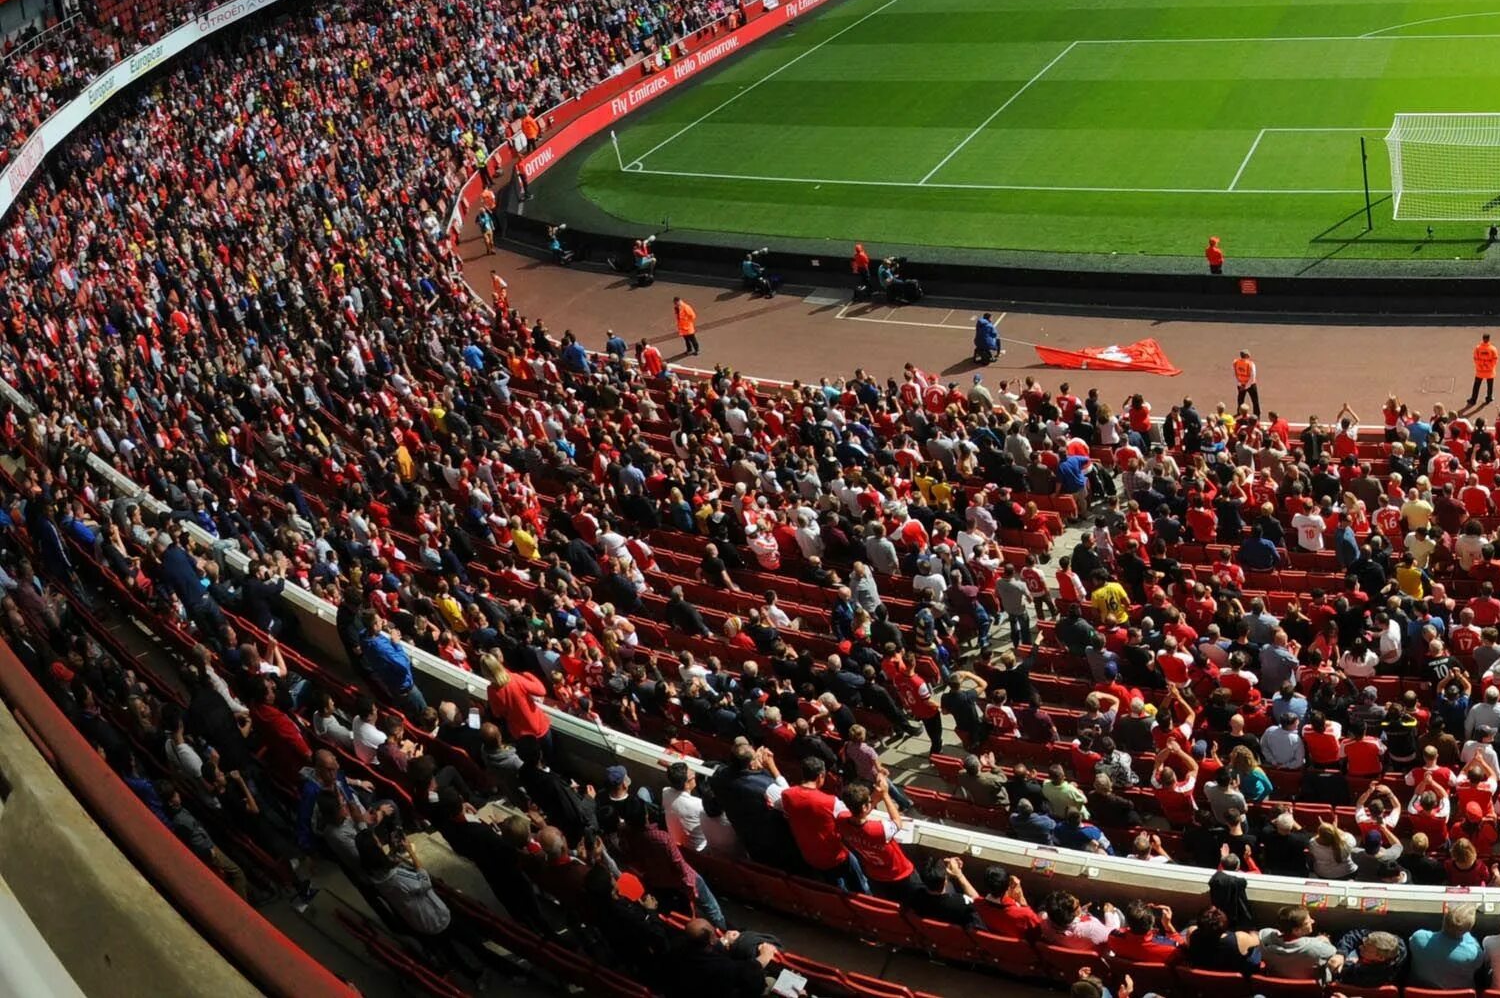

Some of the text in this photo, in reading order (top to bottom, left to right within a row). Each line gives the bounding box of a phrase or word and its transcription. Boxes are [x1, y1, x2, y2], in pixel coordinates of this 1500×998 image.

[786, 2, 798, 18] Fly
[199, 5, 245, 32] CITROËN
[130, 44, 164, 74] Europcar
[611, 36, 740, 116] Fly Emirates. Hello Tomorrow.
[88, 75, 115, 105] Europcar
[931, 395, 938, 405] 4
[1384, 517, 1397, 530] 16
[1196, 609, 1203, 619] 7
[1459, 638, 1473, 651] 17
[1433, 664, 1449, 679] 10
